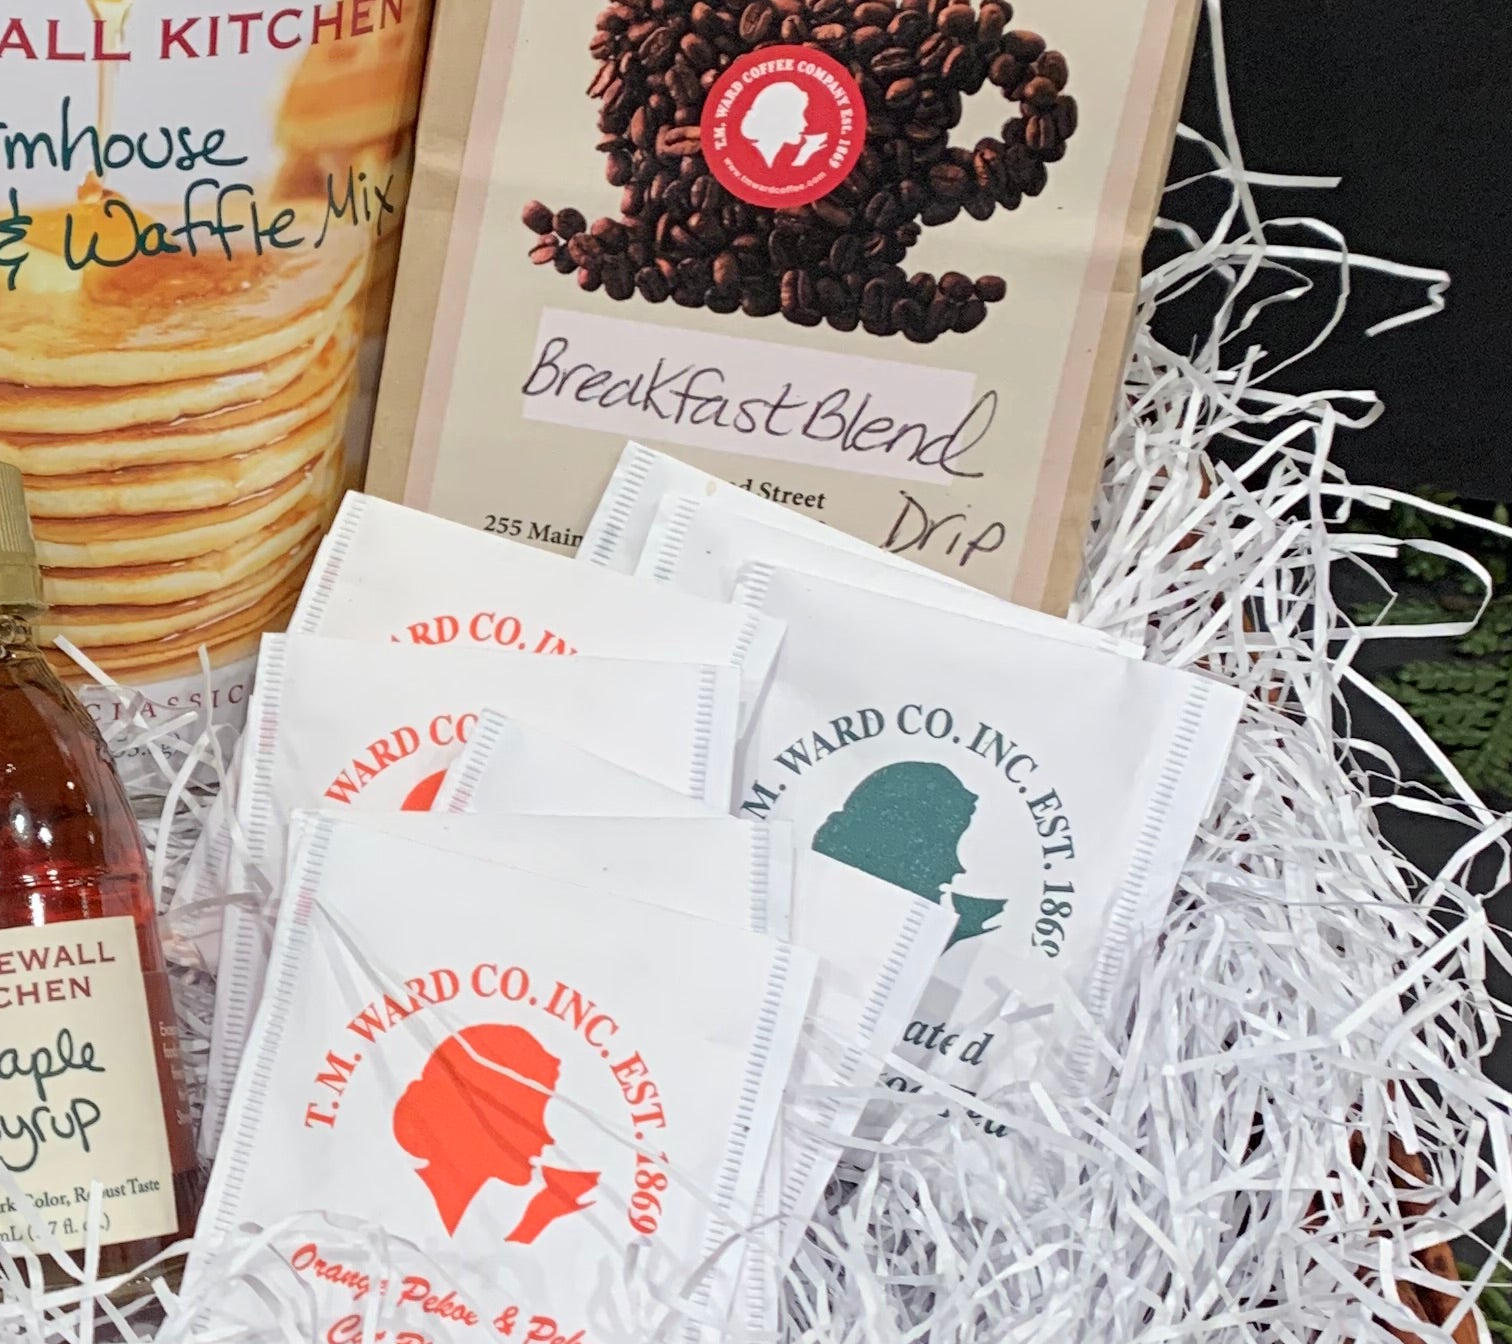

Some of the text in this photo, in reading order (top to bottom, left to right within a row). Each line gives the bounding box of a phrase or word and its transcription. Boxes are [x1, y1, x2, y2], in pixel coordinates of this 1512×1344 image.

[715, 80, 744, 119] WARD
[741, 59, 795, 84] COFFEE
[796, 60, 850, 107] COMPANY
[829, 138, 851, 169] 1869
[64, 177, 306, 271] Waffle
[314, 164, 397, 250] Mix
[483, 513, 522, 537] 255
[758, 480, 826, 512] Street
[880, 489, 1006, 567] Drip
[469, 611, 526, 650] CO.
[324, 724, 421, 805] WARD
[773, 706, 886, 776] WARD
[896, 703, 961, 745] CO.
[965, 721, 1039, 795] INC.
[1025, 787, 1076, 871] EST.
[346, 967, 461, 1044] WARD
[470, 962, 538, 1007] CO.
[543, 980, 620, 1060] INC.
[609, 1050, 667, 1142] EST.
[24, 1191, 71, 1209] olor,
[73, 1183, 126, 1204] Rust
[126, 1177, 161, 1195] Taste
[397, 1274, 479, 1326] Pekoe
[492, 1305, 519, 1337] &
